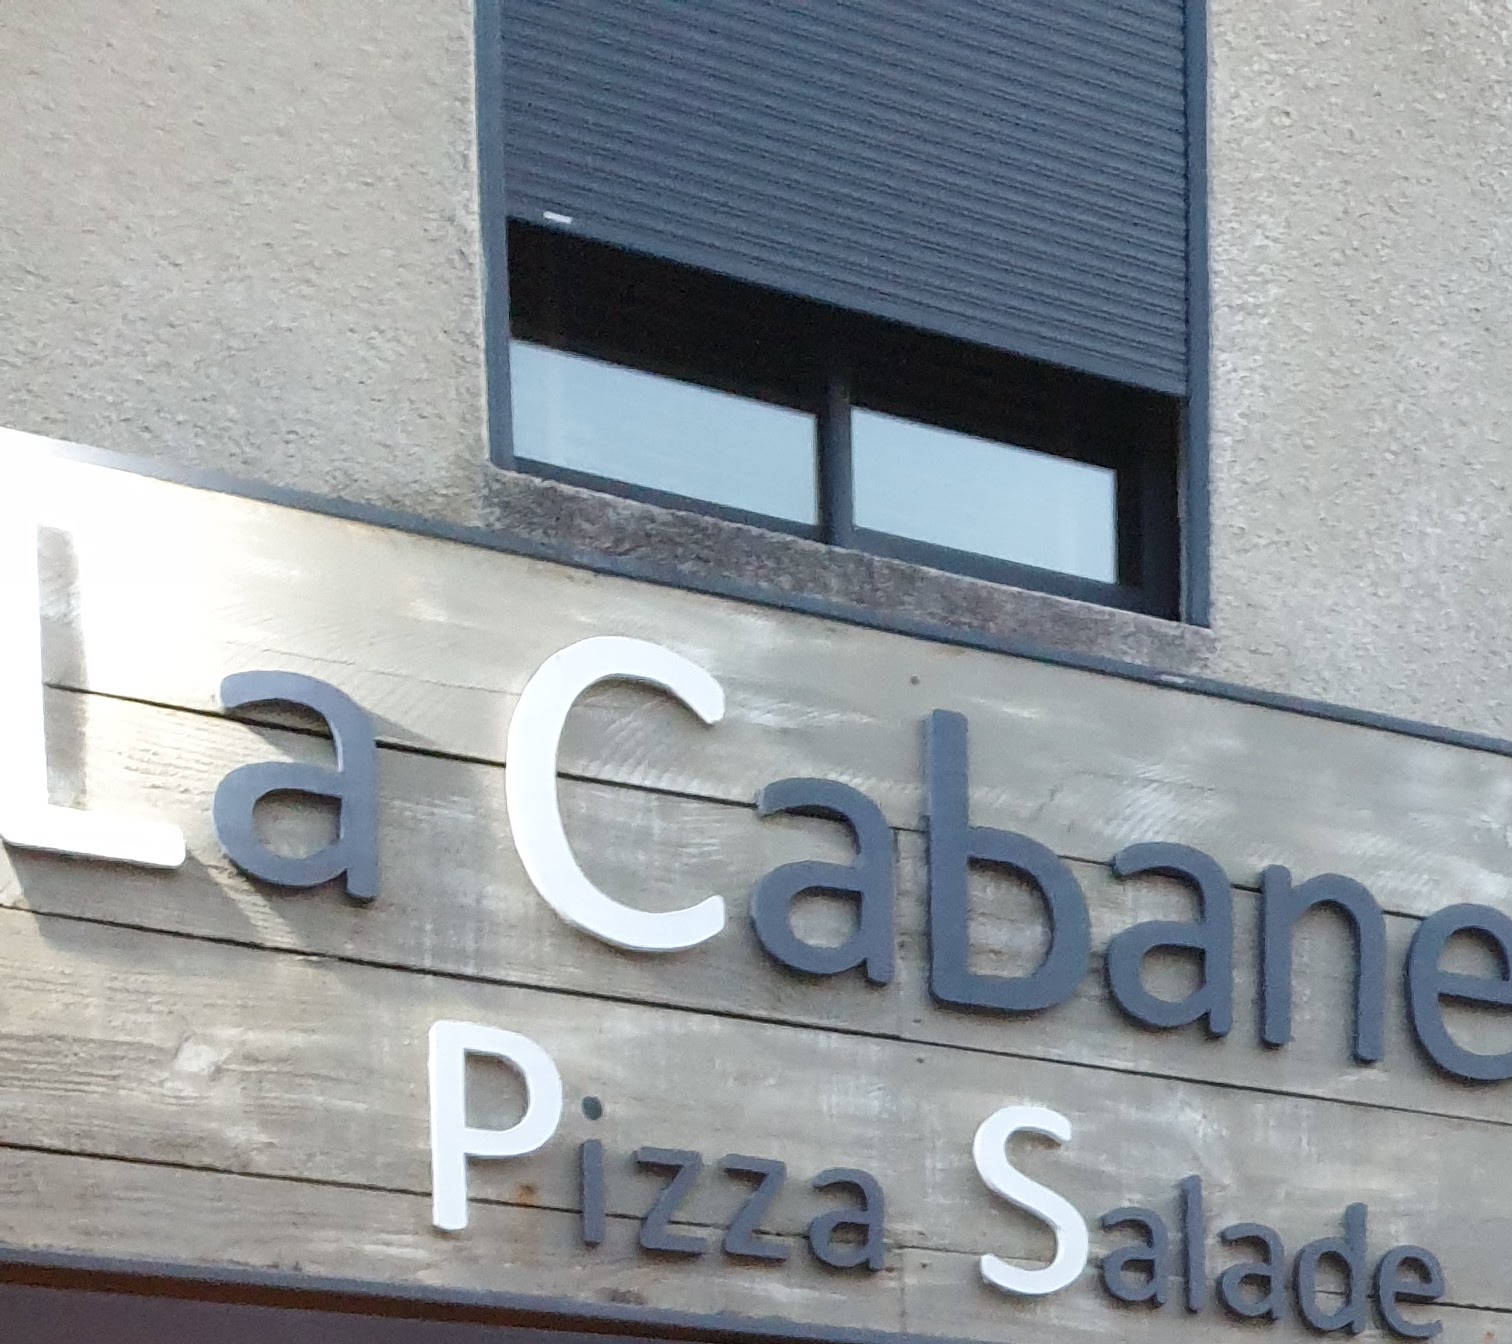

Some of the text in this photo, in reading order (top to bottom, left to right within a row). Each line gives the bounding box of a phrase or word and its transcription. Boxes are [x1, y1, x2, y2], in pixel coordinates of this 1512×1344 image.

[1, 522, 381, 904] La
[428, 1020, 886, 1274] Pizza
[972, 1104, 1446, 1341] Salade
